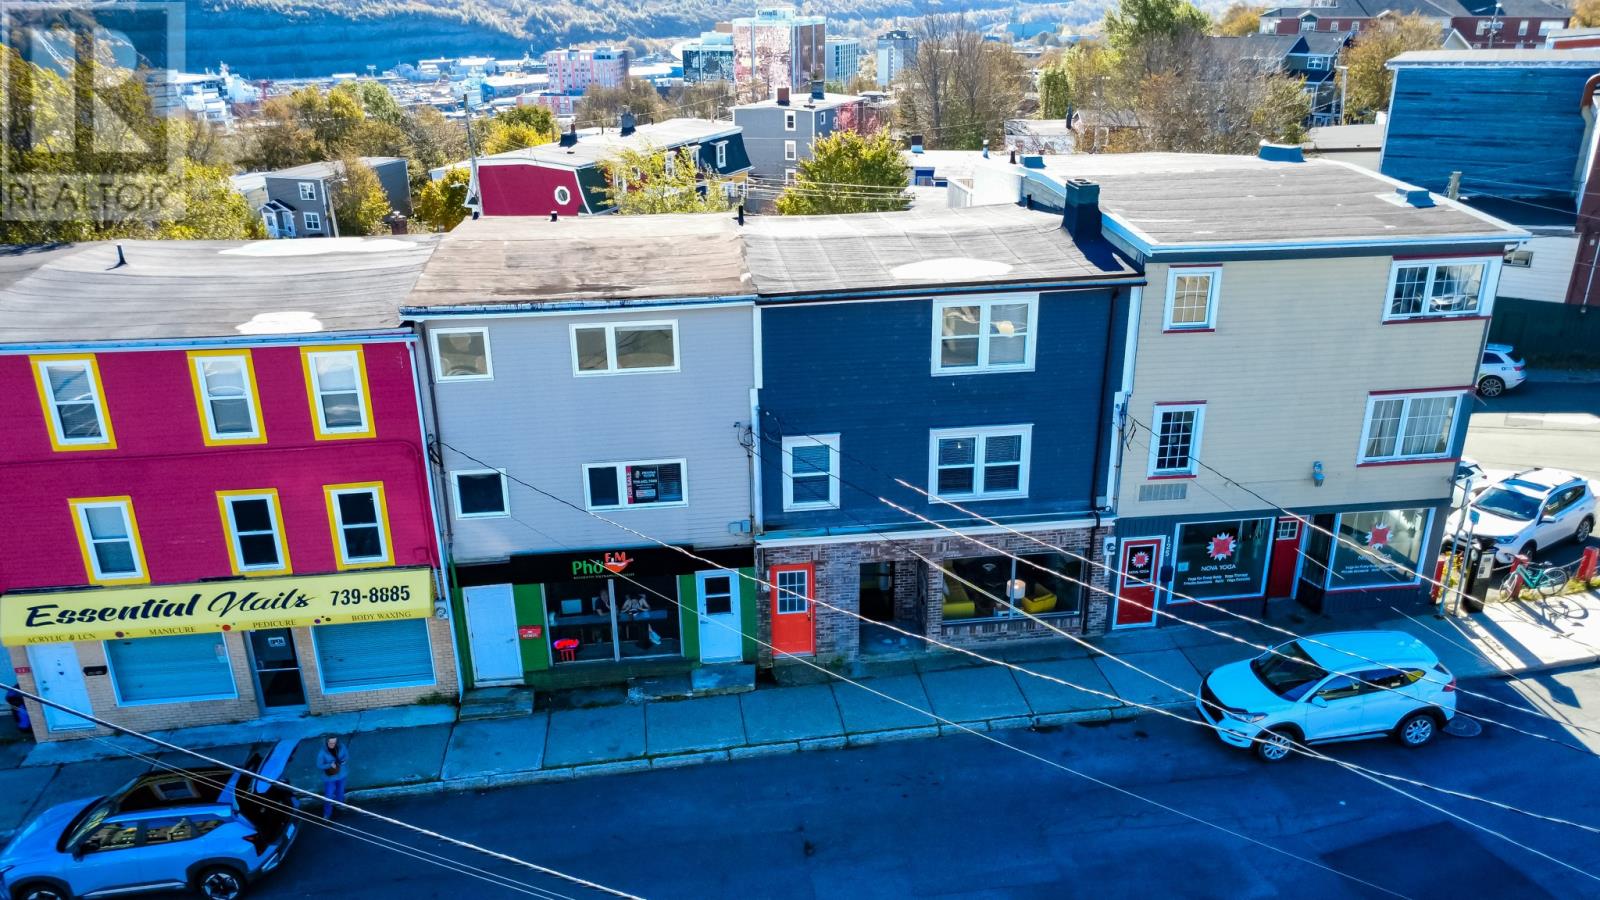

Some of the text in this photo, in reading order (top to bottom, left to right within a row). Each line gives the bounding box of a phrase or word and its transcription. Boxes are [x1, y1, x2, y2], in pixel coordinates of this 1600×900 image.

[25, 585, 410, 628] Essential Nails 739-8885
[351, 611, 411, 622] BODY WAXING
[252, 619, 297, 629] PEDICURE
[149, 626, 197, 636] MANICURE
[28, 633, 96, 644] ACRYLIC & LCN
